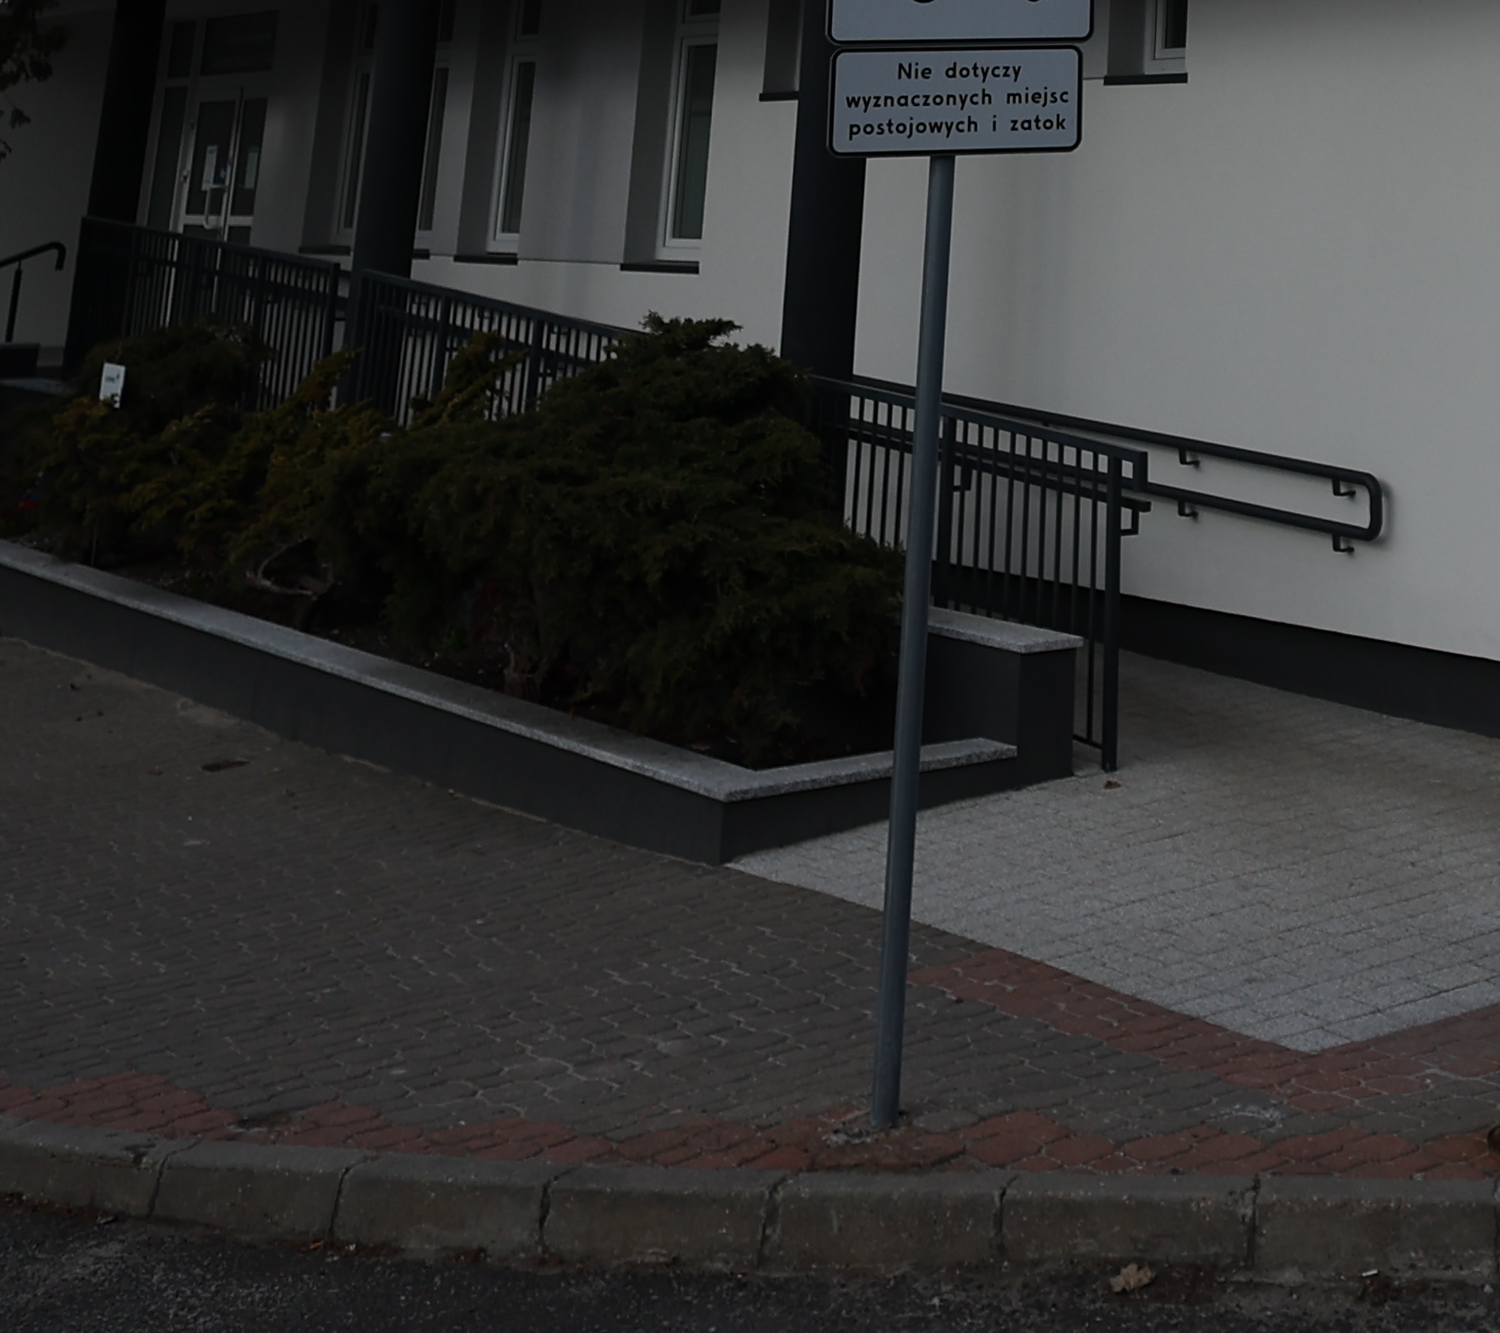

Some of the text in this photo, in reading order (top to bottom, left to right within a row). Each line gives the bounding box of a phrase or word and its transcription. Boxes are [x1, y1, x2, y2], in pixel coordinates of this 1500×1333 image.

[898, 61, 1022, 83] Nie dotyczy
[846, 86, 1069, 112] wyznaczonych miejsc
[849, 113, 1066, 140] postojowych i zatok
